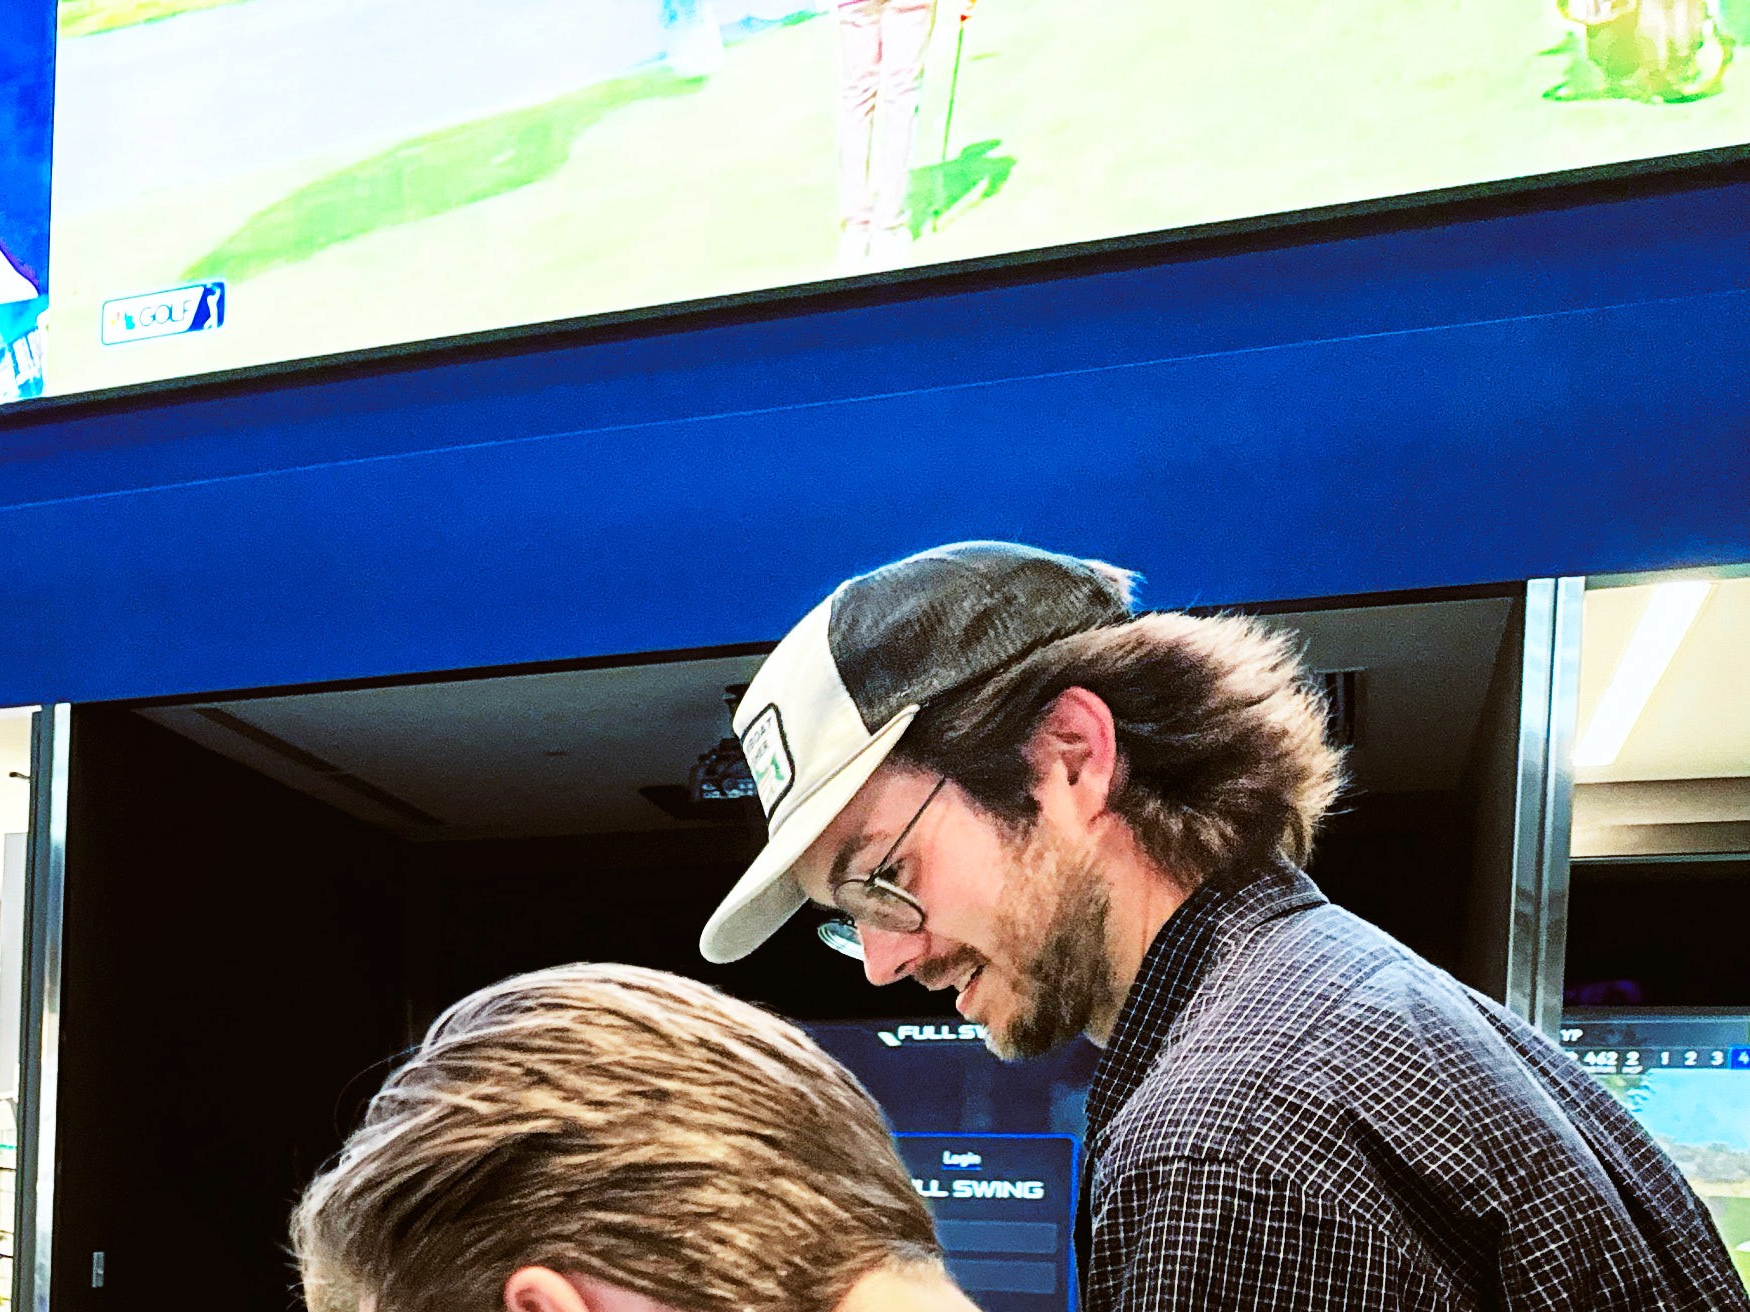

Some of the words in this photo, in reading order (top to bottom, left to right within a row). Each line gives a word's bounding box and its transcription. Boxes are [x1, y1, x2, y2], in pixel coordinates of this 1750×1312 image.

[897, 1025, 957, 1041] FULL
[1625, 1051, 1640, 1066] 2
[1661, 1051, 1670, 1066] 1
[1684, 1051, 1698, 1066] 2
[1711, 1051, 1724, 1066] 3
[952, 1179, 1045, 1199] SWING
